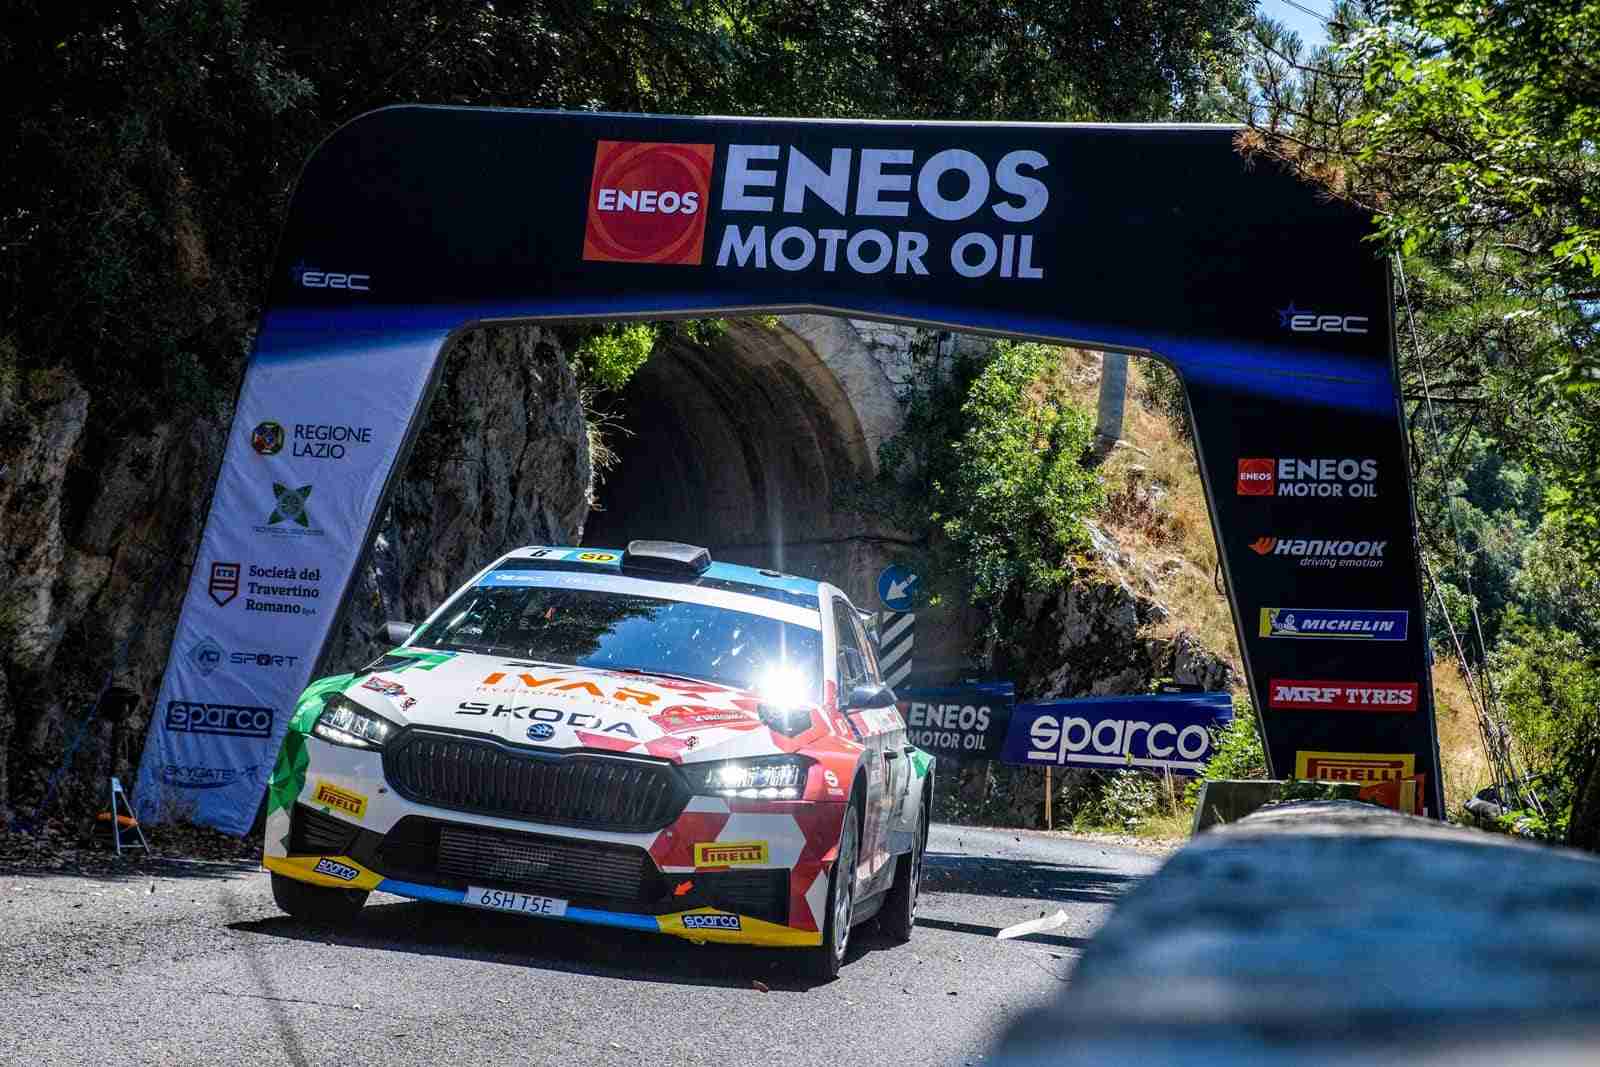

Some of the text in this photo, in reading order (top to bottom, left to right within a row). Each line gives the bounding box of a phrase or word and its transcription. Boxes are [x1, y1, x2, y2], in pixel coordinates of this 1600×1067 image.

[721, 144, 1049, 222] ENEOS
[597, 189, 699, 215] ENEOS
[716, 224, 1044, 279] MOTOR OIL
[302, 271, 370, 290] ERC
[1290, 314, 1368, 333] ERC
[294, 424, 372, 443] REGIONE
[293, 443, 345, 459] LAZIO
[1240, 472, 1272, 481] ENEOS
[1278, 458, 1377, 481] ENEOS
[1278, 483, 1377, 498] MOTOR OIL
[1300, 557, 1383, 568] driving emotion
[249, 565, 321, 581] Società del
[248, 582, 319, 598] Travertino
[245, 598, 301, 614] Romano
[1302, 618, 1395, 632] MICHELIN
[229, 651, 299, 667] SPORT
[483, 672, 660, 706] IVAR
[1274, 686, 1413, 705] MRF TYRES
[170, 703, 271, 732] sparco
[910, 702, 991, 731] ENEOS
[908, 730, 986, 750] MOTOR OIL
[1030, 714, 1210, 764] sparco
[1307, 758, 1404, 781] PIRELLI
[318, 786, 362, 814] PIRELLI
[702, 847, 761, 862] PIRELLI
[480, 889, 516, 909] 6SH
[684, 916, 739, 928] sparco
